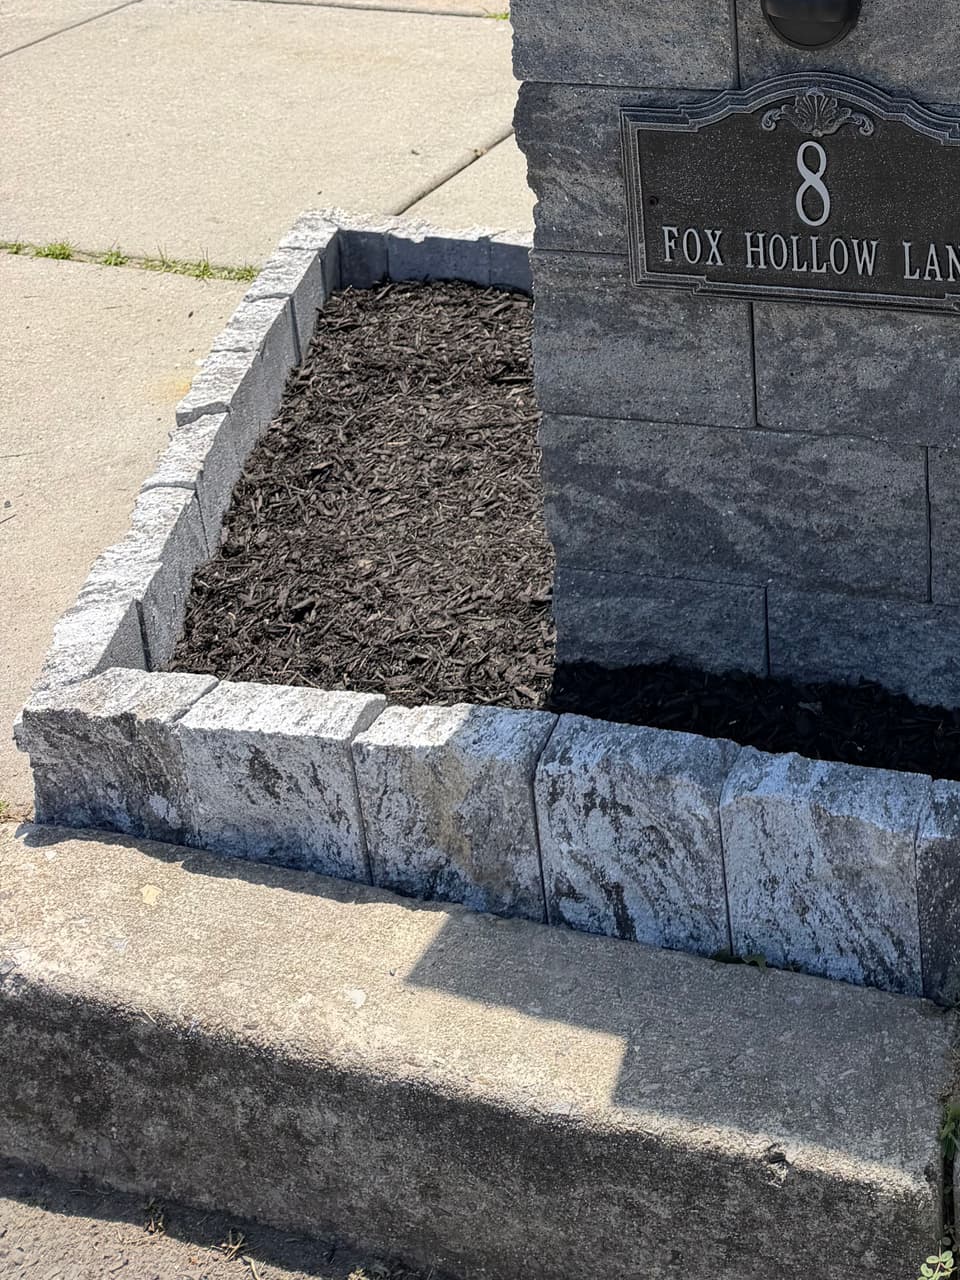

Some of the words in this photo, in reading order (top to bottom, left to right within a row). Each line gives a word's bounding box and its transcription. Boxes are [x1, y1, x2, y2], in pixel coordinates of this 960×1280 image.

[795, 140, 831, 227] 8
[662, 226, 725, 267] FOX
[744, 231, 879, 277] HOLLOW
